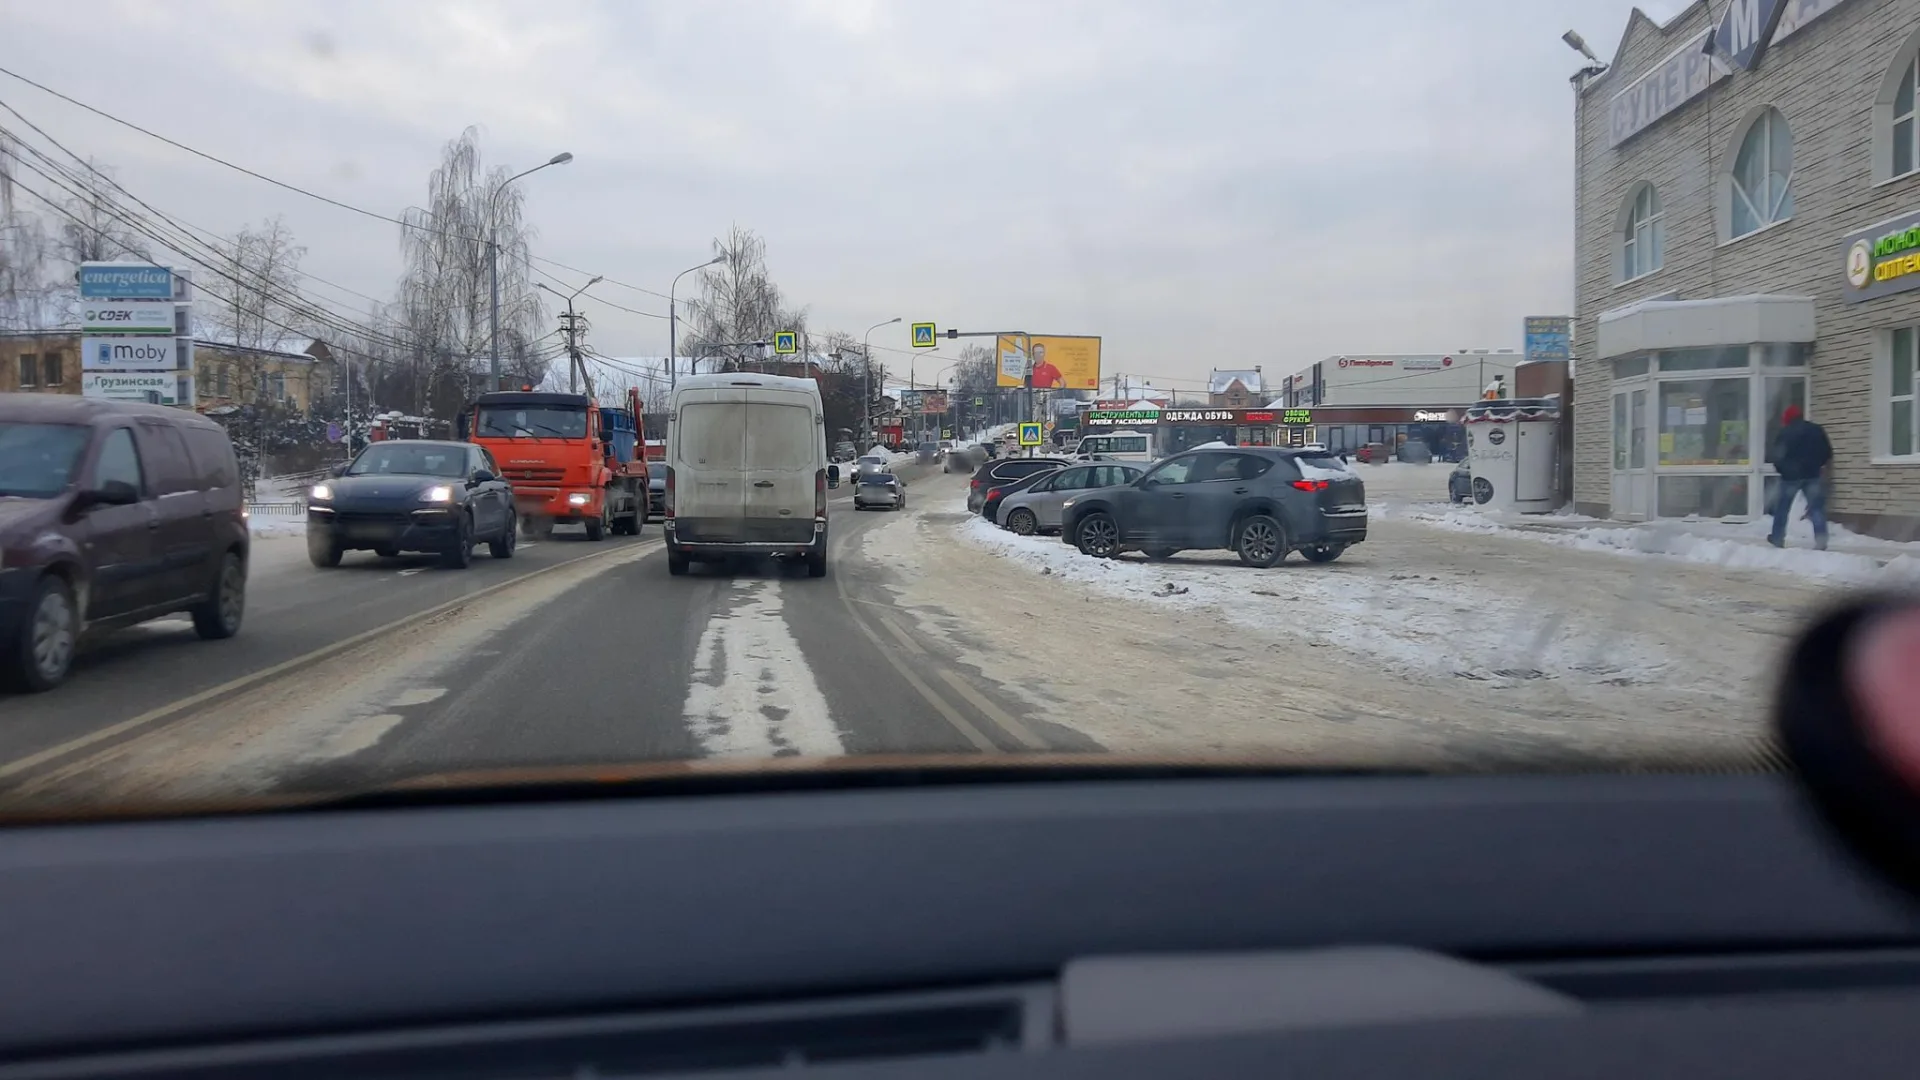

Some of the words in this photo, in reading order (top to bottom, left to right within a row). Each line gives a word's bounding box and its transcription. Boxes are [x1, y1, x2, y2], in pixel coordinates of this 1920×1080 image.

[84, 269, 167, 287] energetica
[98, 310, 133, 321] CDEK
[94, 376, 164, 388] Грузинская
[1166, 411, 1203, 421] ОДЕЖДА
[1205, 411, 1234, 420] ОБУВЬ
